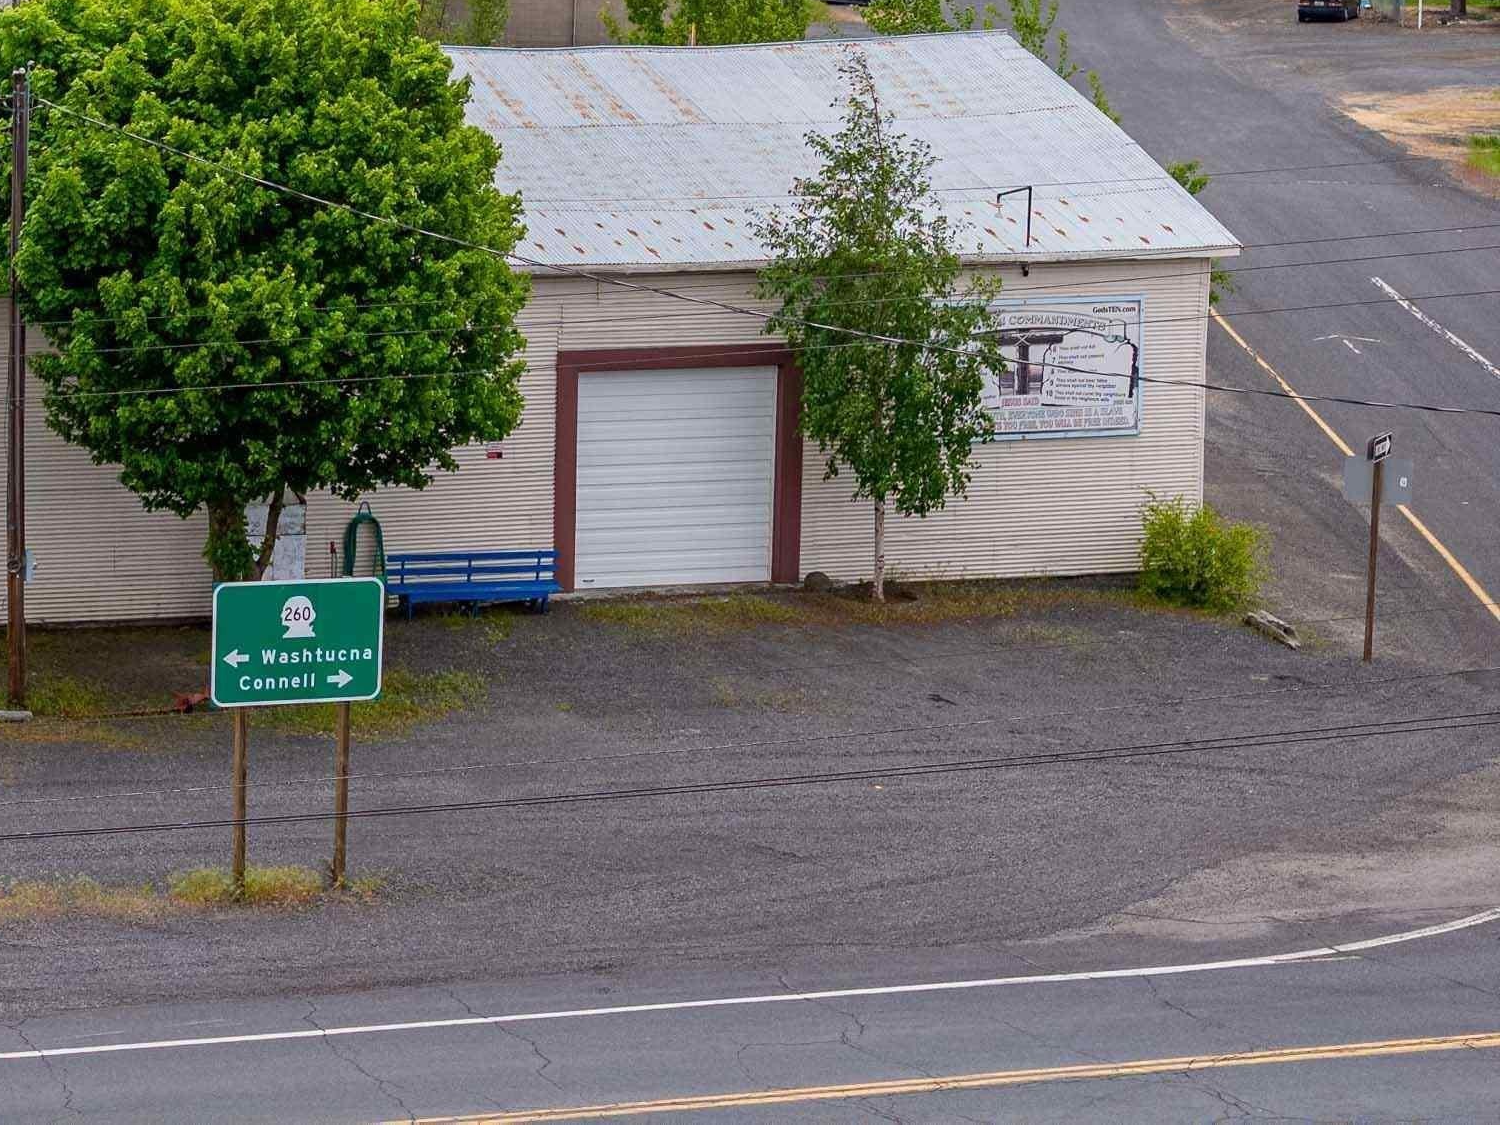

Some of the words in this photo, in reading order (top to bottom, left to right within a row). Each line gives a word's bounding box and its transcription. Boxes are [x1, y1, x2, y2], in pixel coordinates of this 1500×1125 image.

[284, 606, 311, 622] 260
[261, 647, 373, 665] Washtucna
[239, 672, 316, 691] Connell
